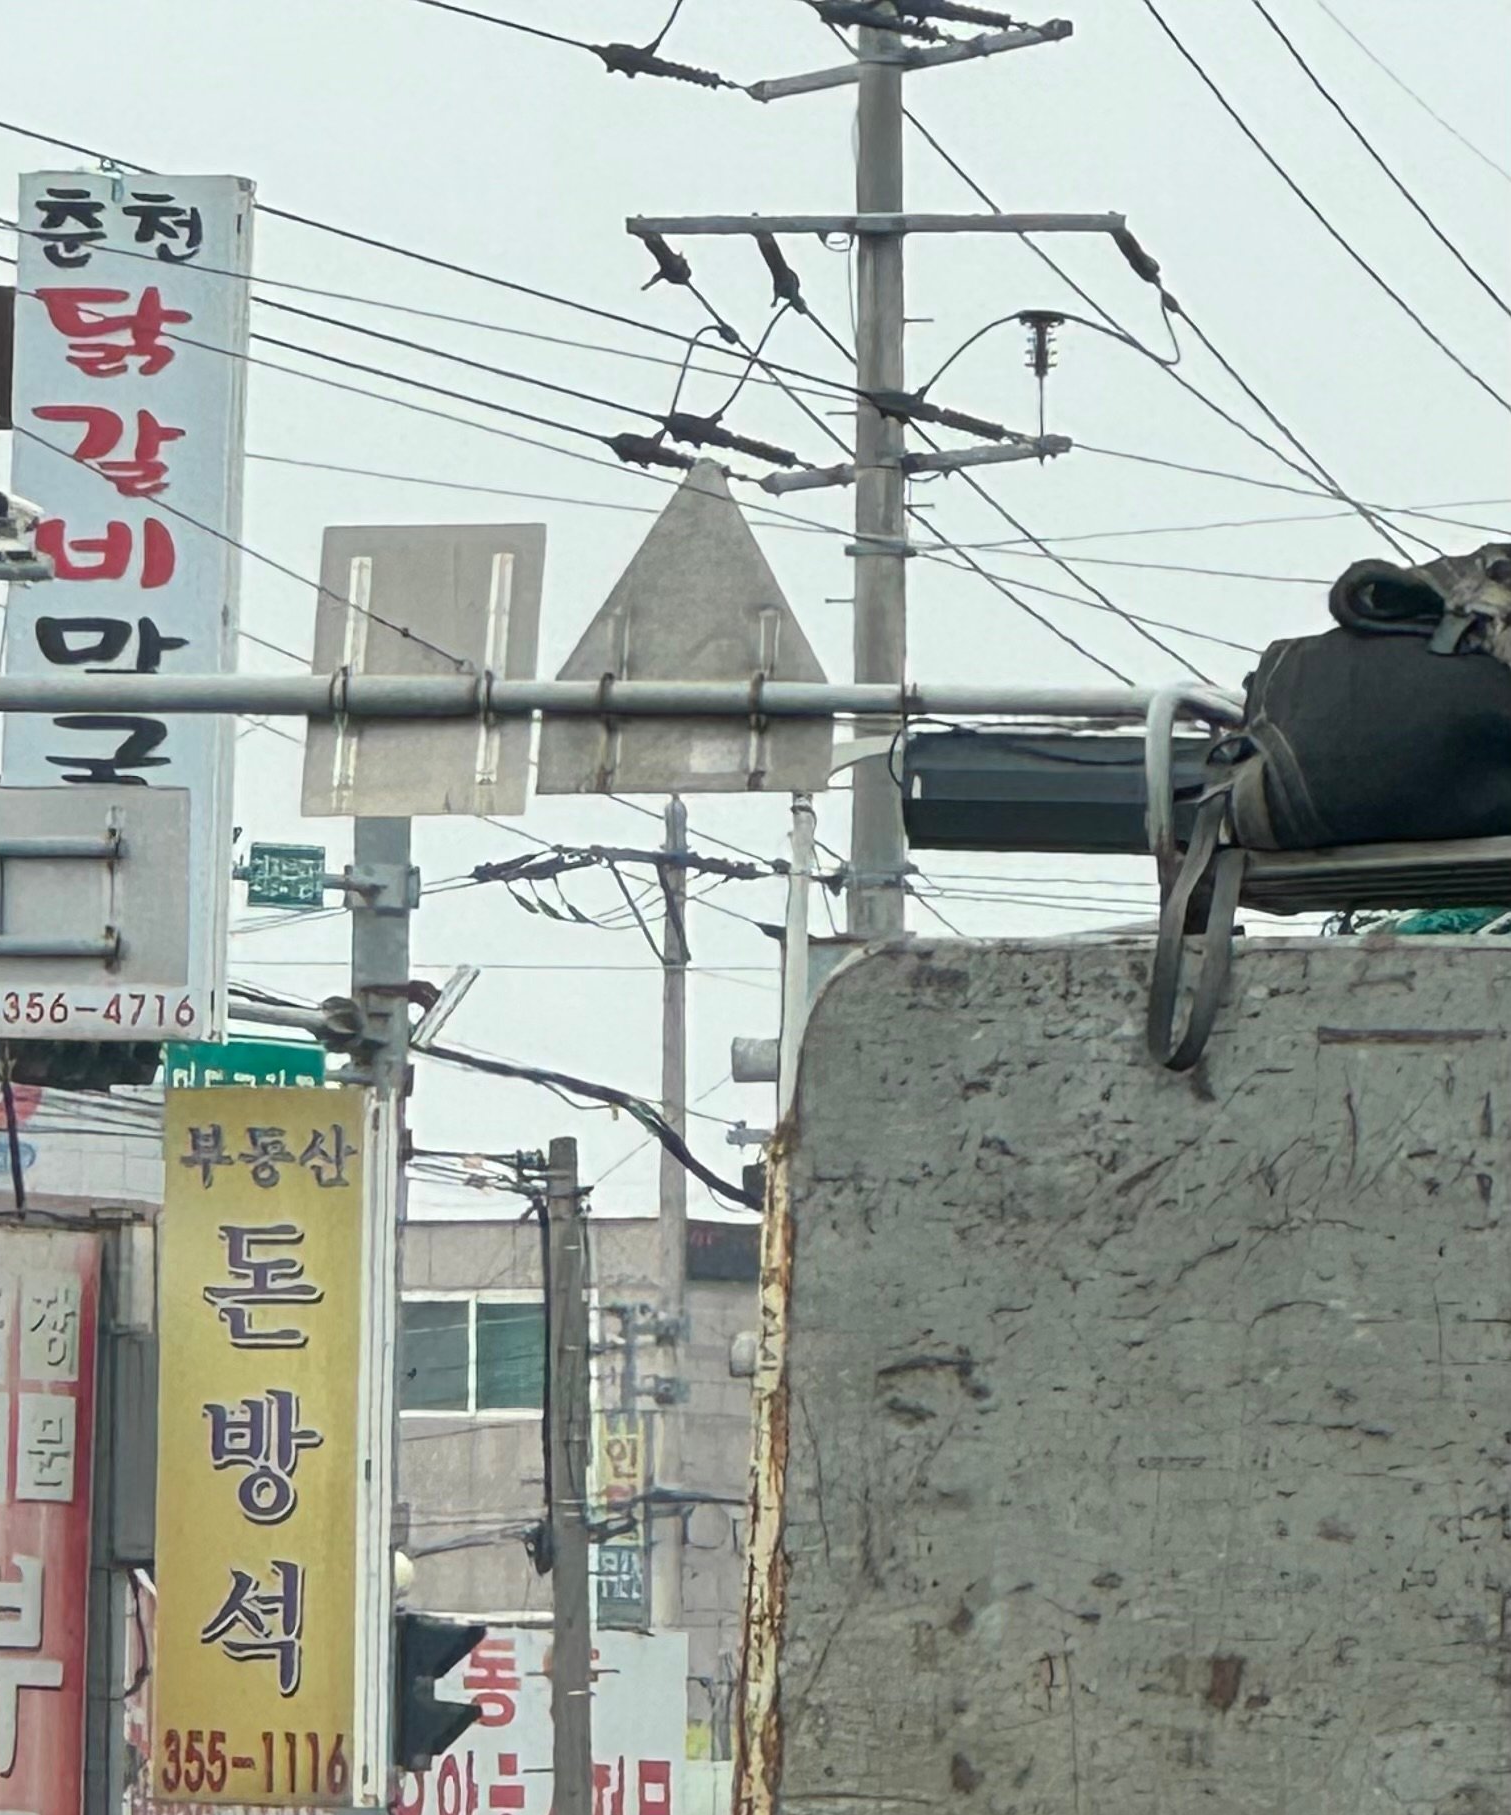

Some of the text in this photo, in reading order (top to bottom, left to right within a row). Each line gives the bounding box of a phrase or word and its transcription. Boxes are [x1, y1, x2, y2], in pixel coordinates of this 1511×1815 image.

[34, 187, 203, 268] 춘천
[31, 286, 192, 589] 닭갈비
[2, 991, 196, 1027] 356-4716
[180, 1123, 358, 1189] 부동산
[201, 1223, 325, 1698] 돈방석
[161, 1728, 349, 1795] 355-1116
